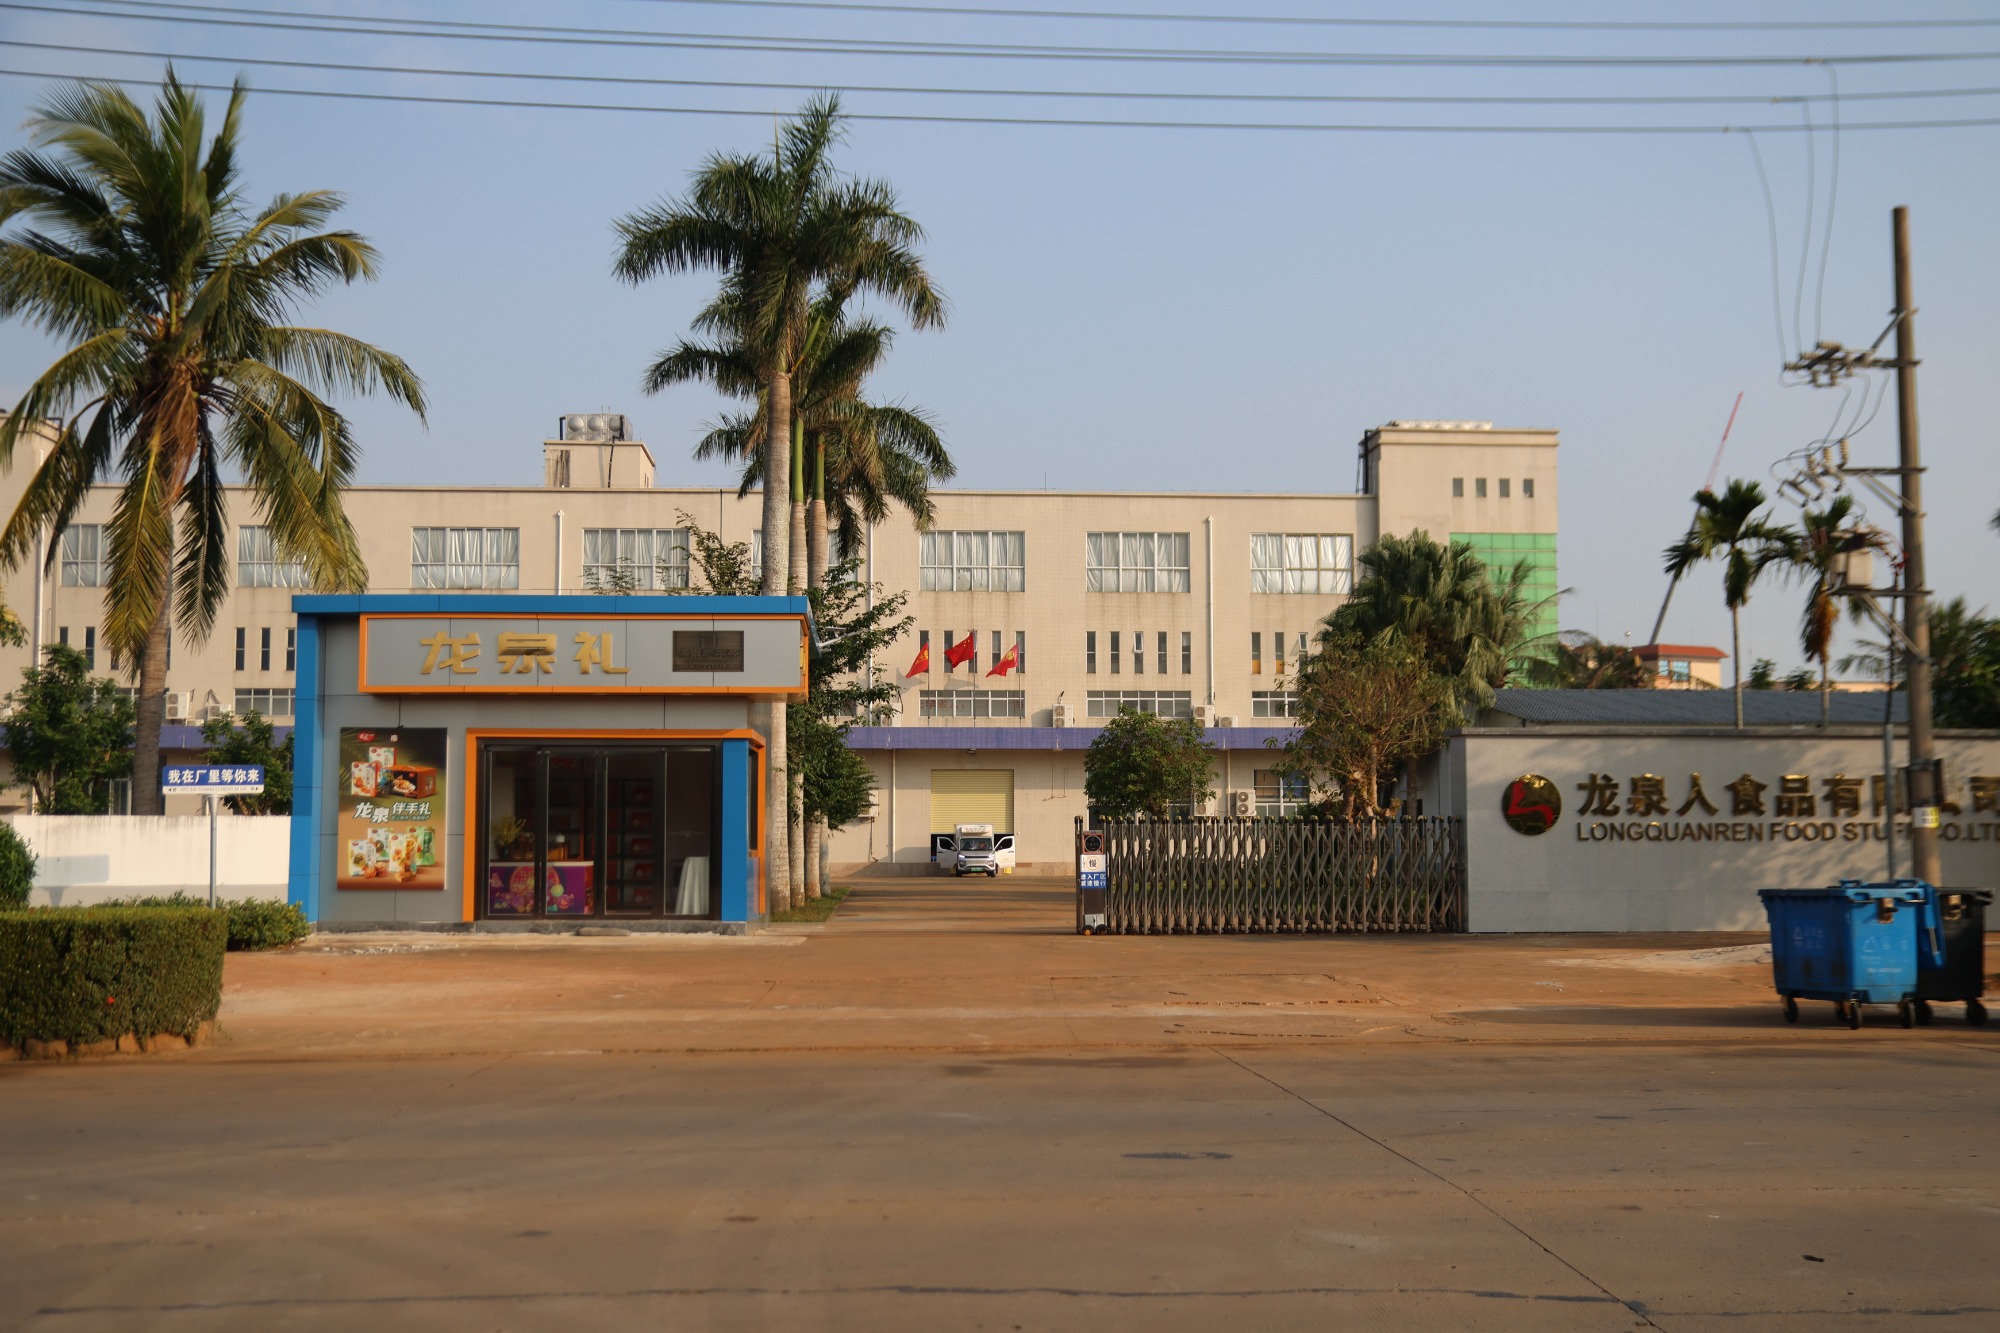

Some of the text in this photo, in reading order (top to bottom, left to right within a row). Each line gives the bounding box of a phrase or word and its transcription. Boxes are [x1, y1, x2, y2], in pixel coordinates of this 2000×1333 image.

[421, 631, 630, 674] 龙泉礼
[168, 768, 260, 783] 我在厂里等你来
[1577, 772, 2000, 817] 龙泉人食品有司
[354, 802, 431, 823] 龙泉 伴手礼
[1577, 821, 1764, 842] LONGQUANREN
[1770, 821, 1837, 842] FOOD
